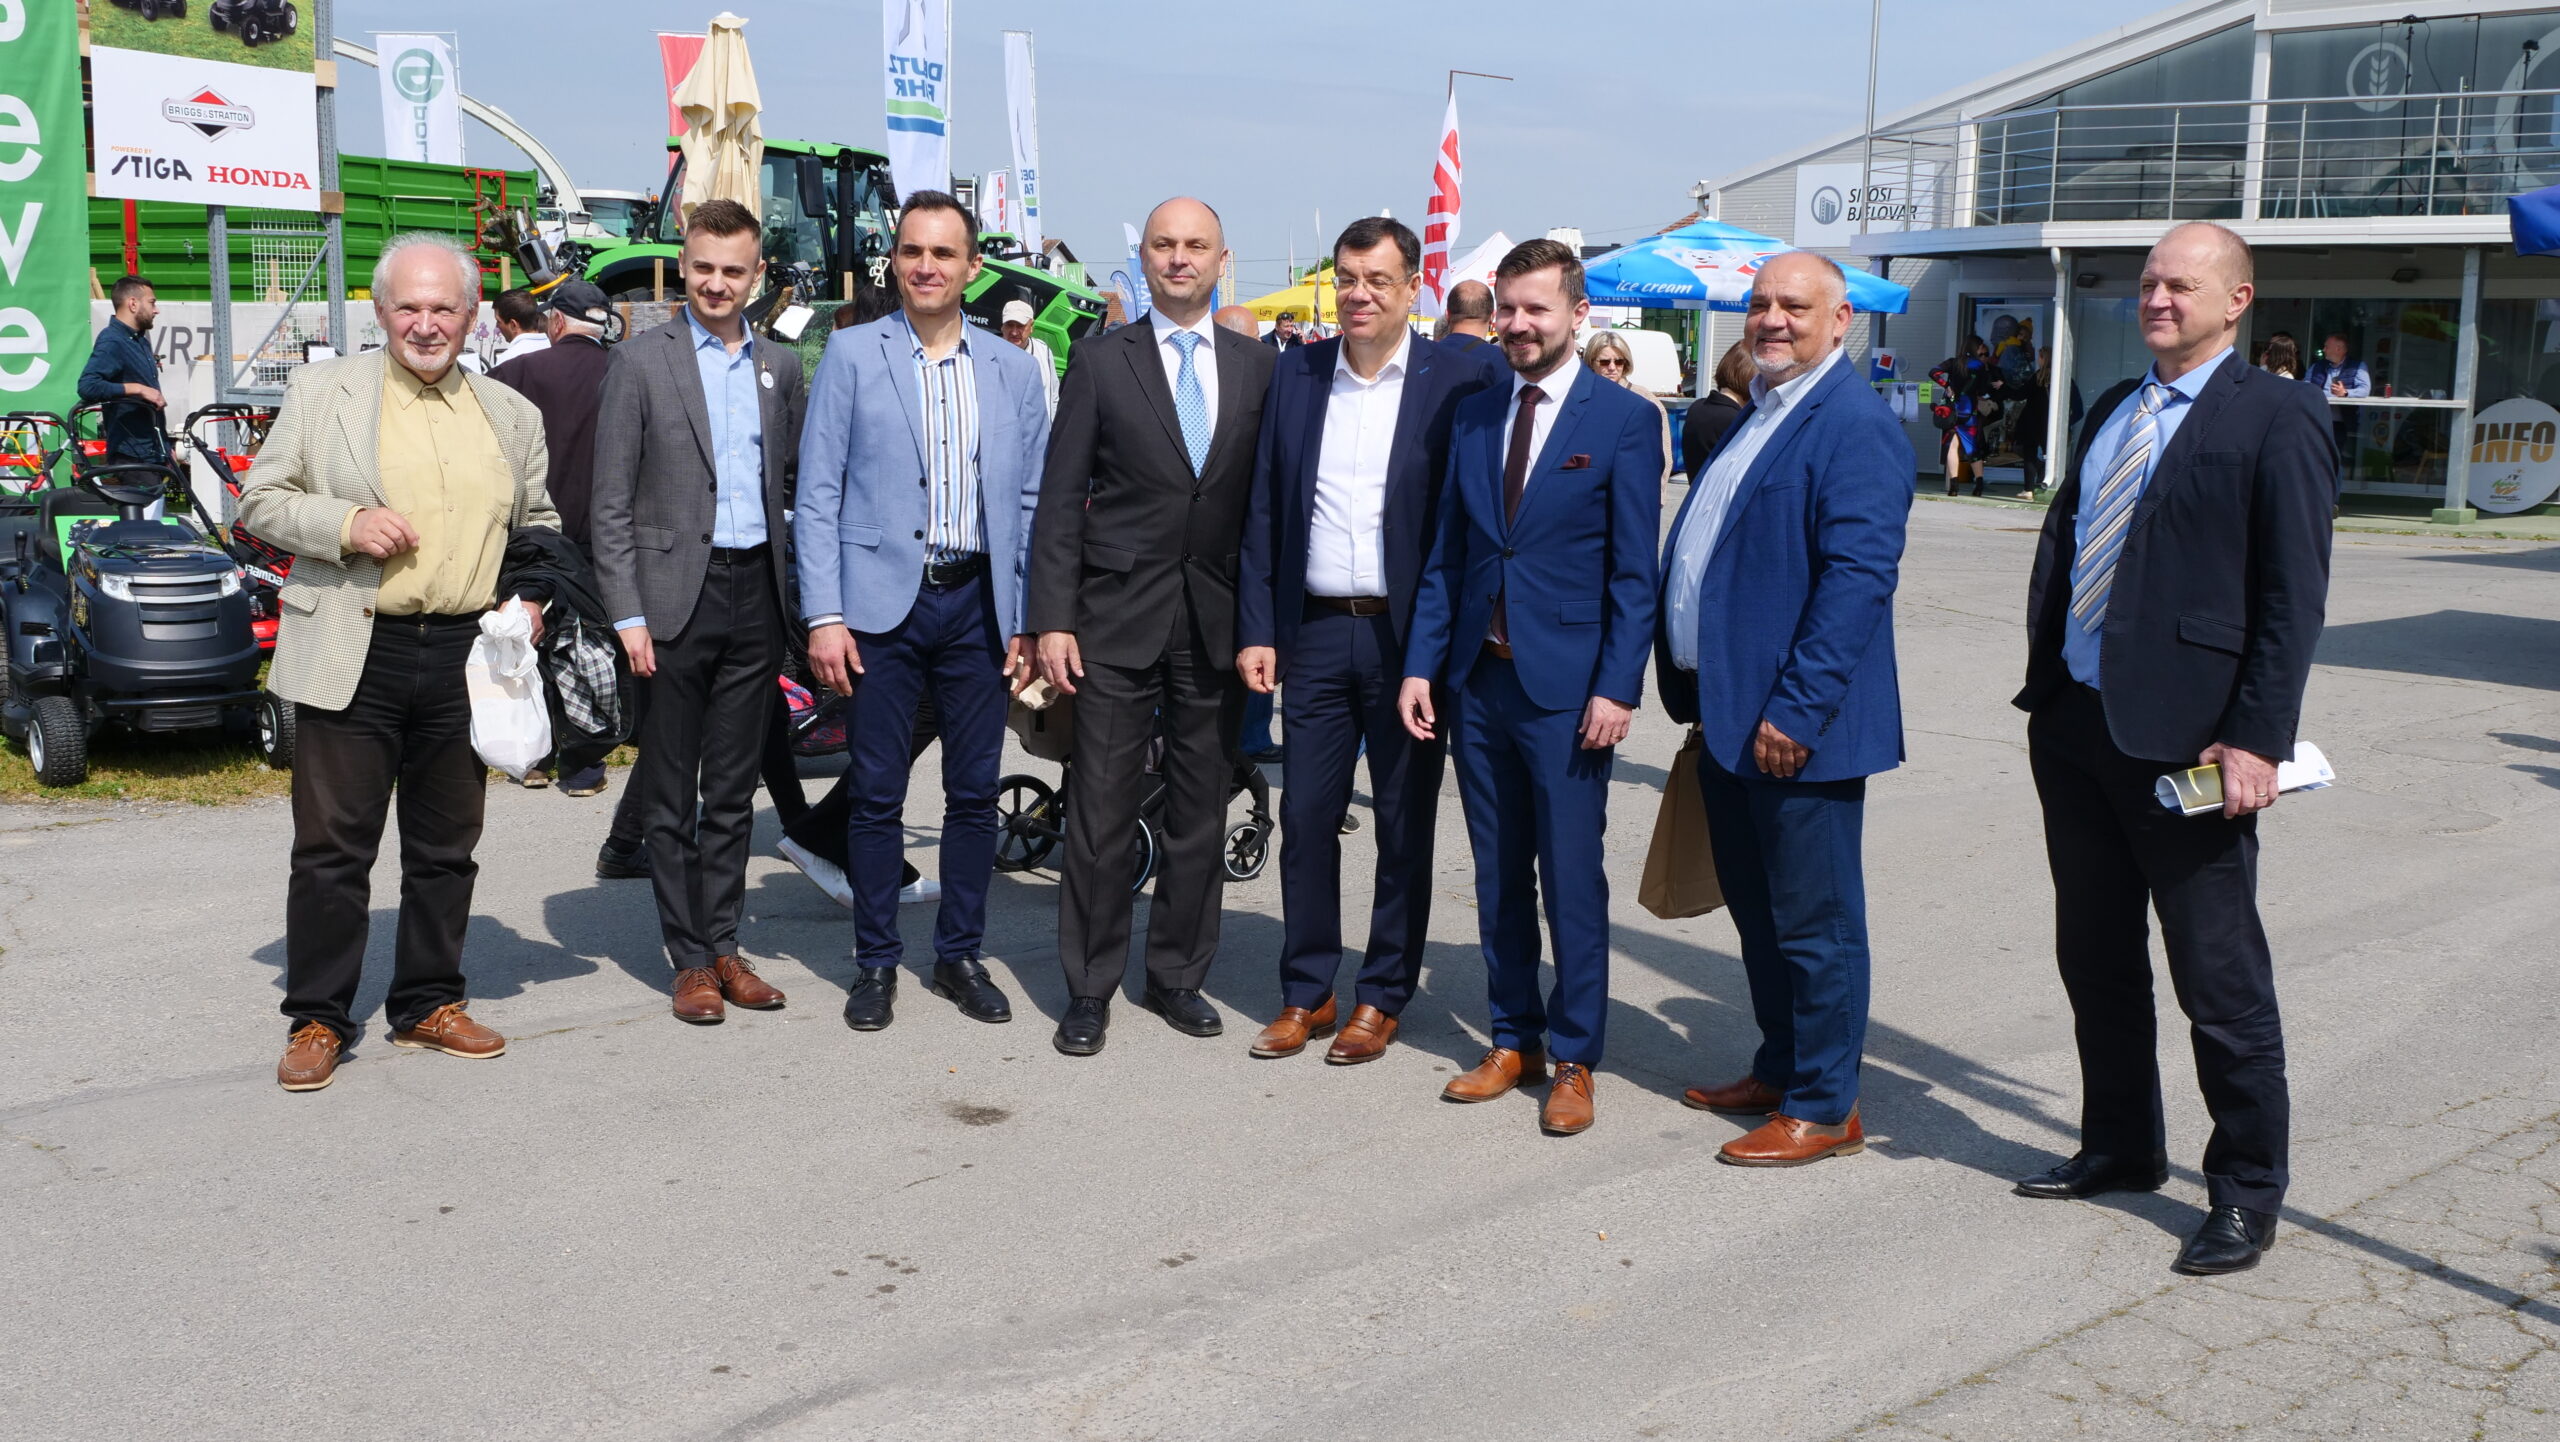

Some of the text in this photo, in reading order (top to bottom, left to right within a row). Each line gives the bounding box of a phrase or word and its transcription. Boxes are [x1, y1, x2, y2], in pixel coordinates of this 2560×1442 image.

[111, 145, 143, 154] POWERED
[111, 155, 192, 182] STIGA
[207, 165, 312, 190] HONDA
[1848, 187, 1892, 203] SIOSI
[1616, 279, 1694, 294] ice cream
[965, 313, 989, 326] AHR
[2470, 421, 2557, 464] INFO
